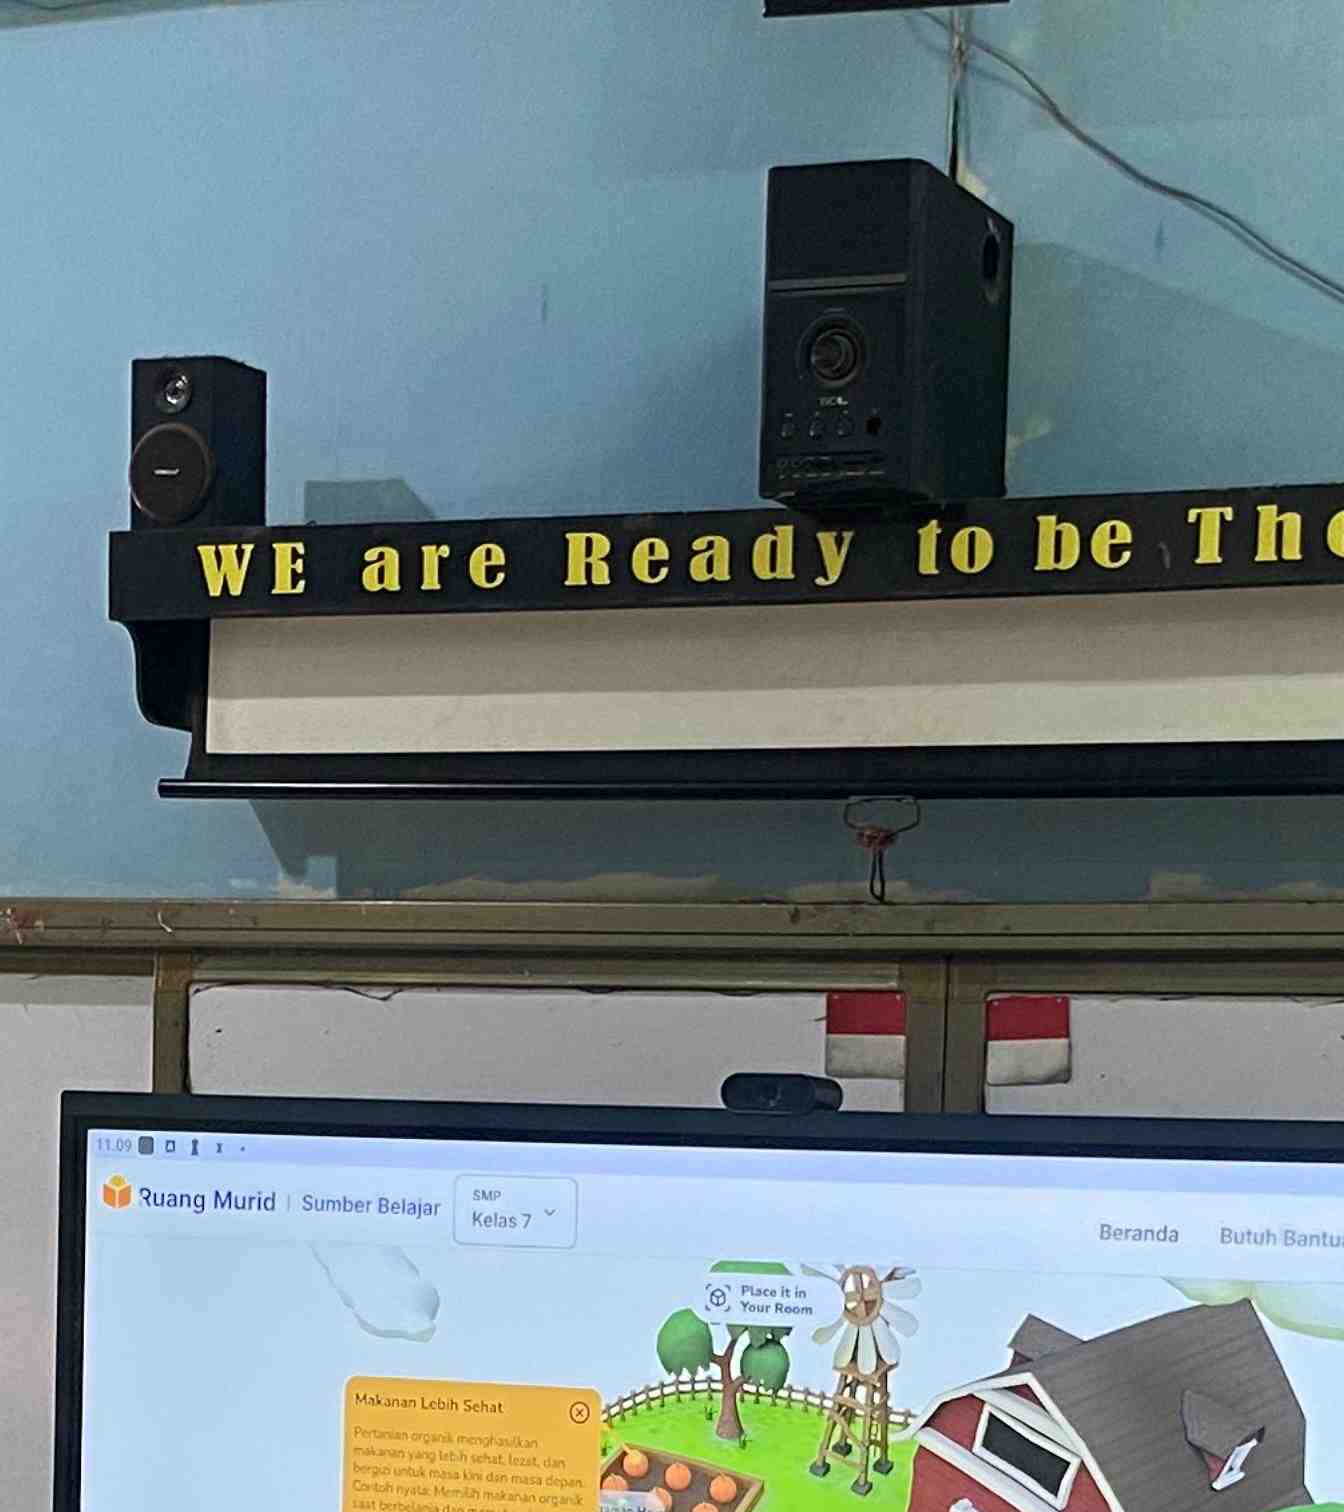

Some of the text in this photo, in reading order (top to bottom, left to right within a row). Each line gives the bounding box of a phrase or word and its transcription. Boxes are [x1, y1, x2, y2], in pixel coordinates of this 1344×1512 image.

[196, 541, 306, 596] WE
[361, 541, 506, 592] are
[563, 525, 854, 587] Ready
[917, 519, 994, 574] to
[1034, 514, 1133, 571] be
[139, 1187, 276, 1214] Ruang Murid
[472, 1189, 501, 1201] SMP
[301, 1194, 441, 1219] Sumber Belajar
[471, 1210, 532, 1229] Kelas 7
[1099, 1223, 1179, 1243] Beranda
[1219, 1227, 1277, 1246] Butuh
[741, 1285, 807, 1299] Place it in
[740, 1300, 813, 1315] Your Room
[355, 1392, 505, 1415] Makanan Lebih Sehat
[354, 1426, 407, 1440] Pertanian
[411, 1431, 453, 1445] organik
[353, 1446, 405, 1459] makanan
[408, 1449, 436, 1464] yang
[439, 1450, 468, 1463] lebih
[543, 1456, 566, 1469] dan
[393, 1465, 426, 1478] untuk
[429, 1469, 460, 1481] masa
[462, 1468, 483, 1482] kini
[485, 1471, 507, 1484] dan
[511, 1475, 542, 1487] masa
[353, 1479, 394, 1493] Contoh
[483, 1489, 537, 1503] makanan
[539, 1493, 584, 1507] organik
